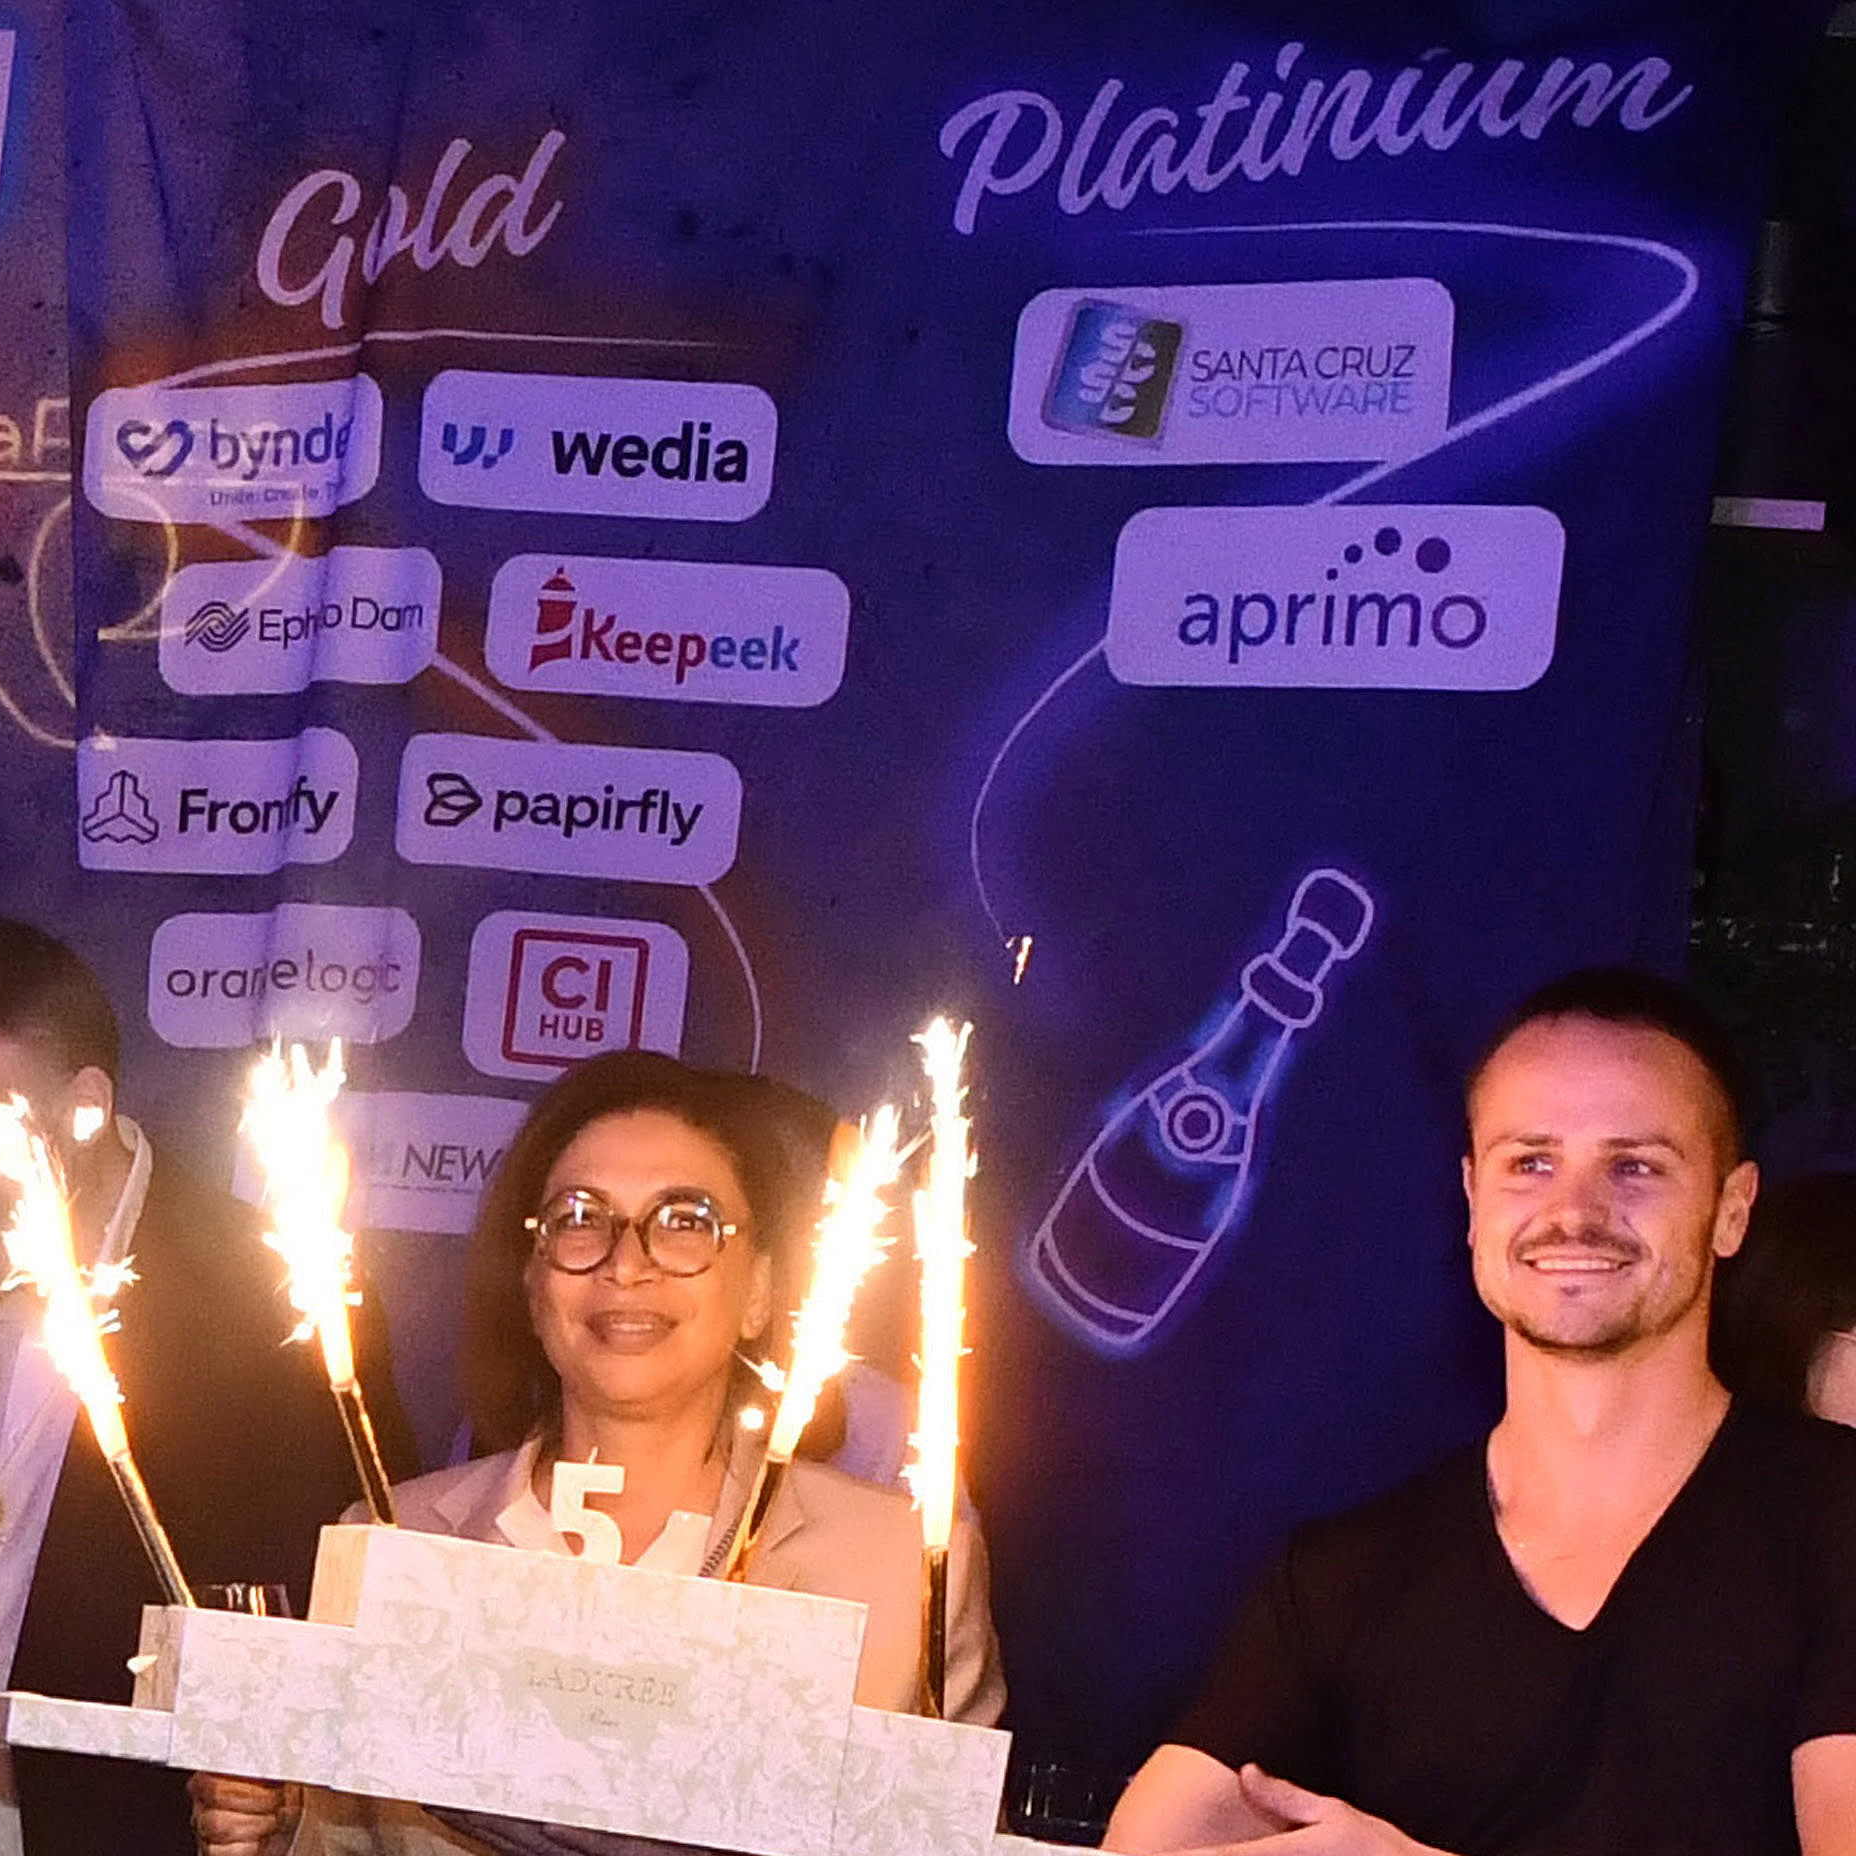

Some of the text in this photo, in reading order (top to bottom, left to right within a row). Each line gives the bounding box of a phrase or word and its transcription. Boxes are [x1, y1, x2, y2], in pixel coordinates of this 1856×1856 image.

[938, 42, 1693, 234] Platinium
[256, 130, 566, 328] Gold
[1192, 345, 1416, 382] SANTA CRUZ
[1189, 382, 1415, 418] SOFTWARE
[551, 420, 749, 484] wedia
[351, 596, 424, 632] Dam
[1178, 570, 1487, 665] aprimo
[582, 606, 802, 685] Keepeek
[494, 784, 703, 845] papirfly
[541, 955, 613, 1013] CI
[539, 1014, 605, 1042] HUB
[401, 1142, 504, 1183] NEW
[549, 1458, 626, 1565] 5
